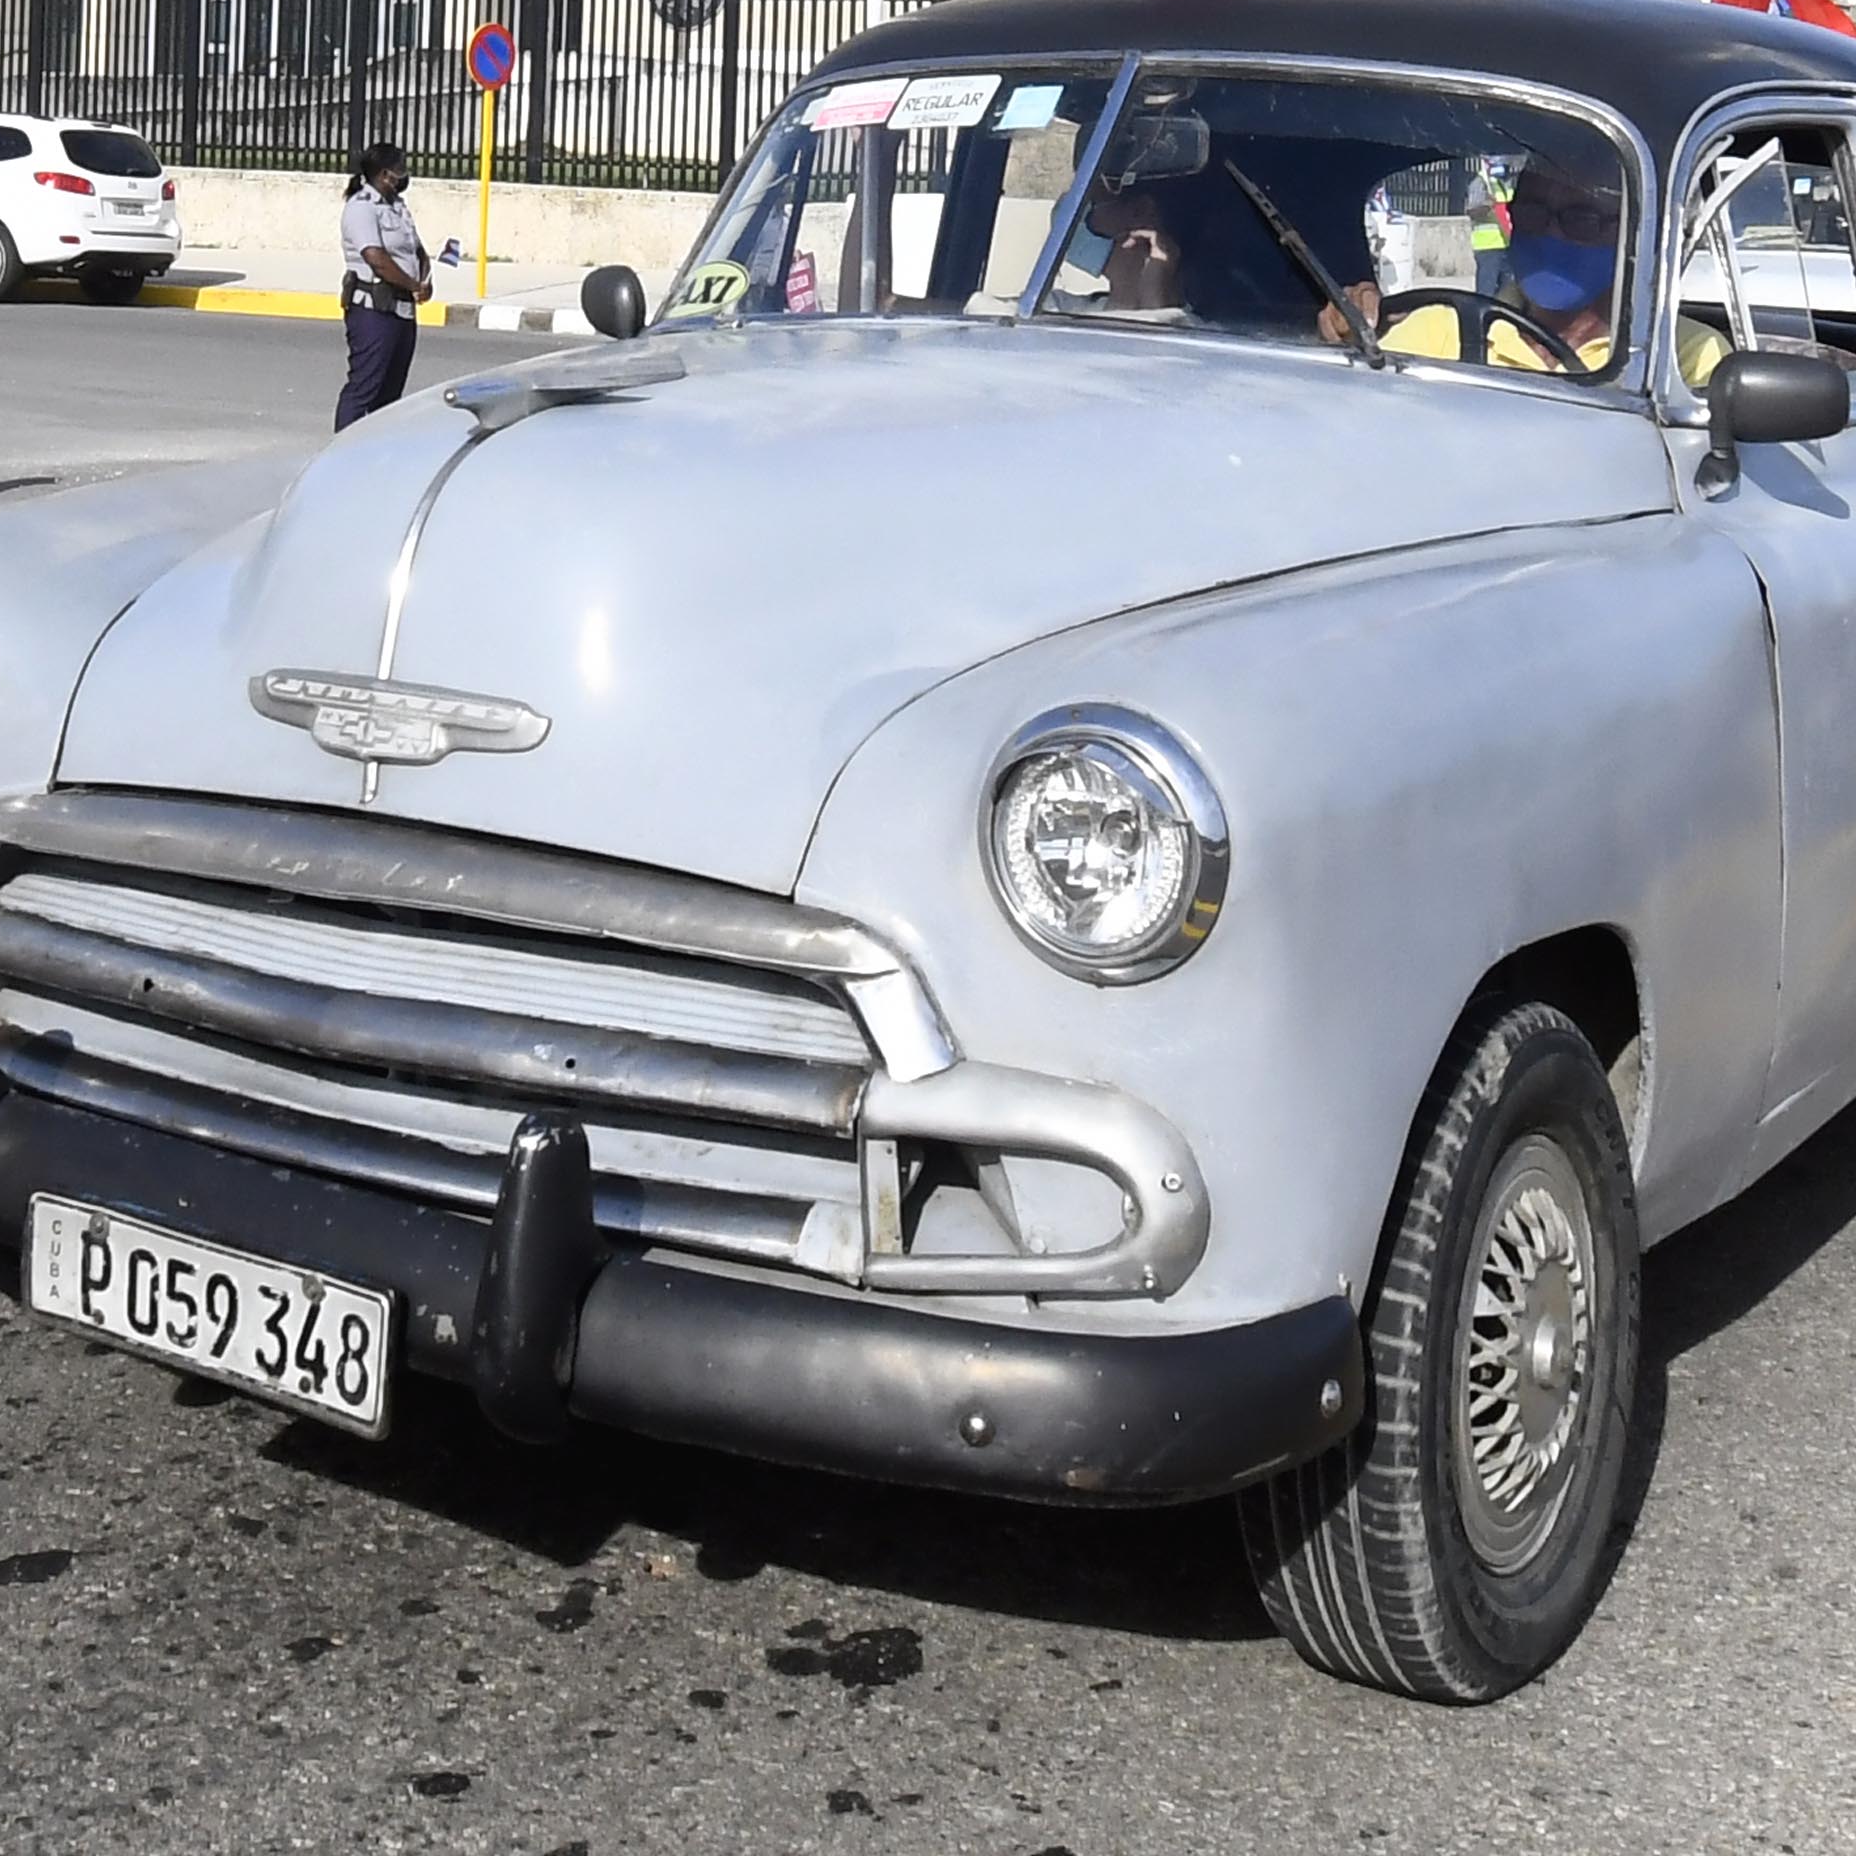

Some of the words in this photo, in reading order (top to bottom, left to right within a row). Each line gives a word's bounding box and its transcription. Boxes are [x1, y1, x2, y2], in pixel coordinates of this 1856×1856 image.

[901, 91, 985, 114] REGULAR
[670, 275, 739, 309] AXI
[49, 1218, 63, 1299] CUBA
[126, 1247, 240, 1361] 059
[255, 1285, 371, 1406] 348
